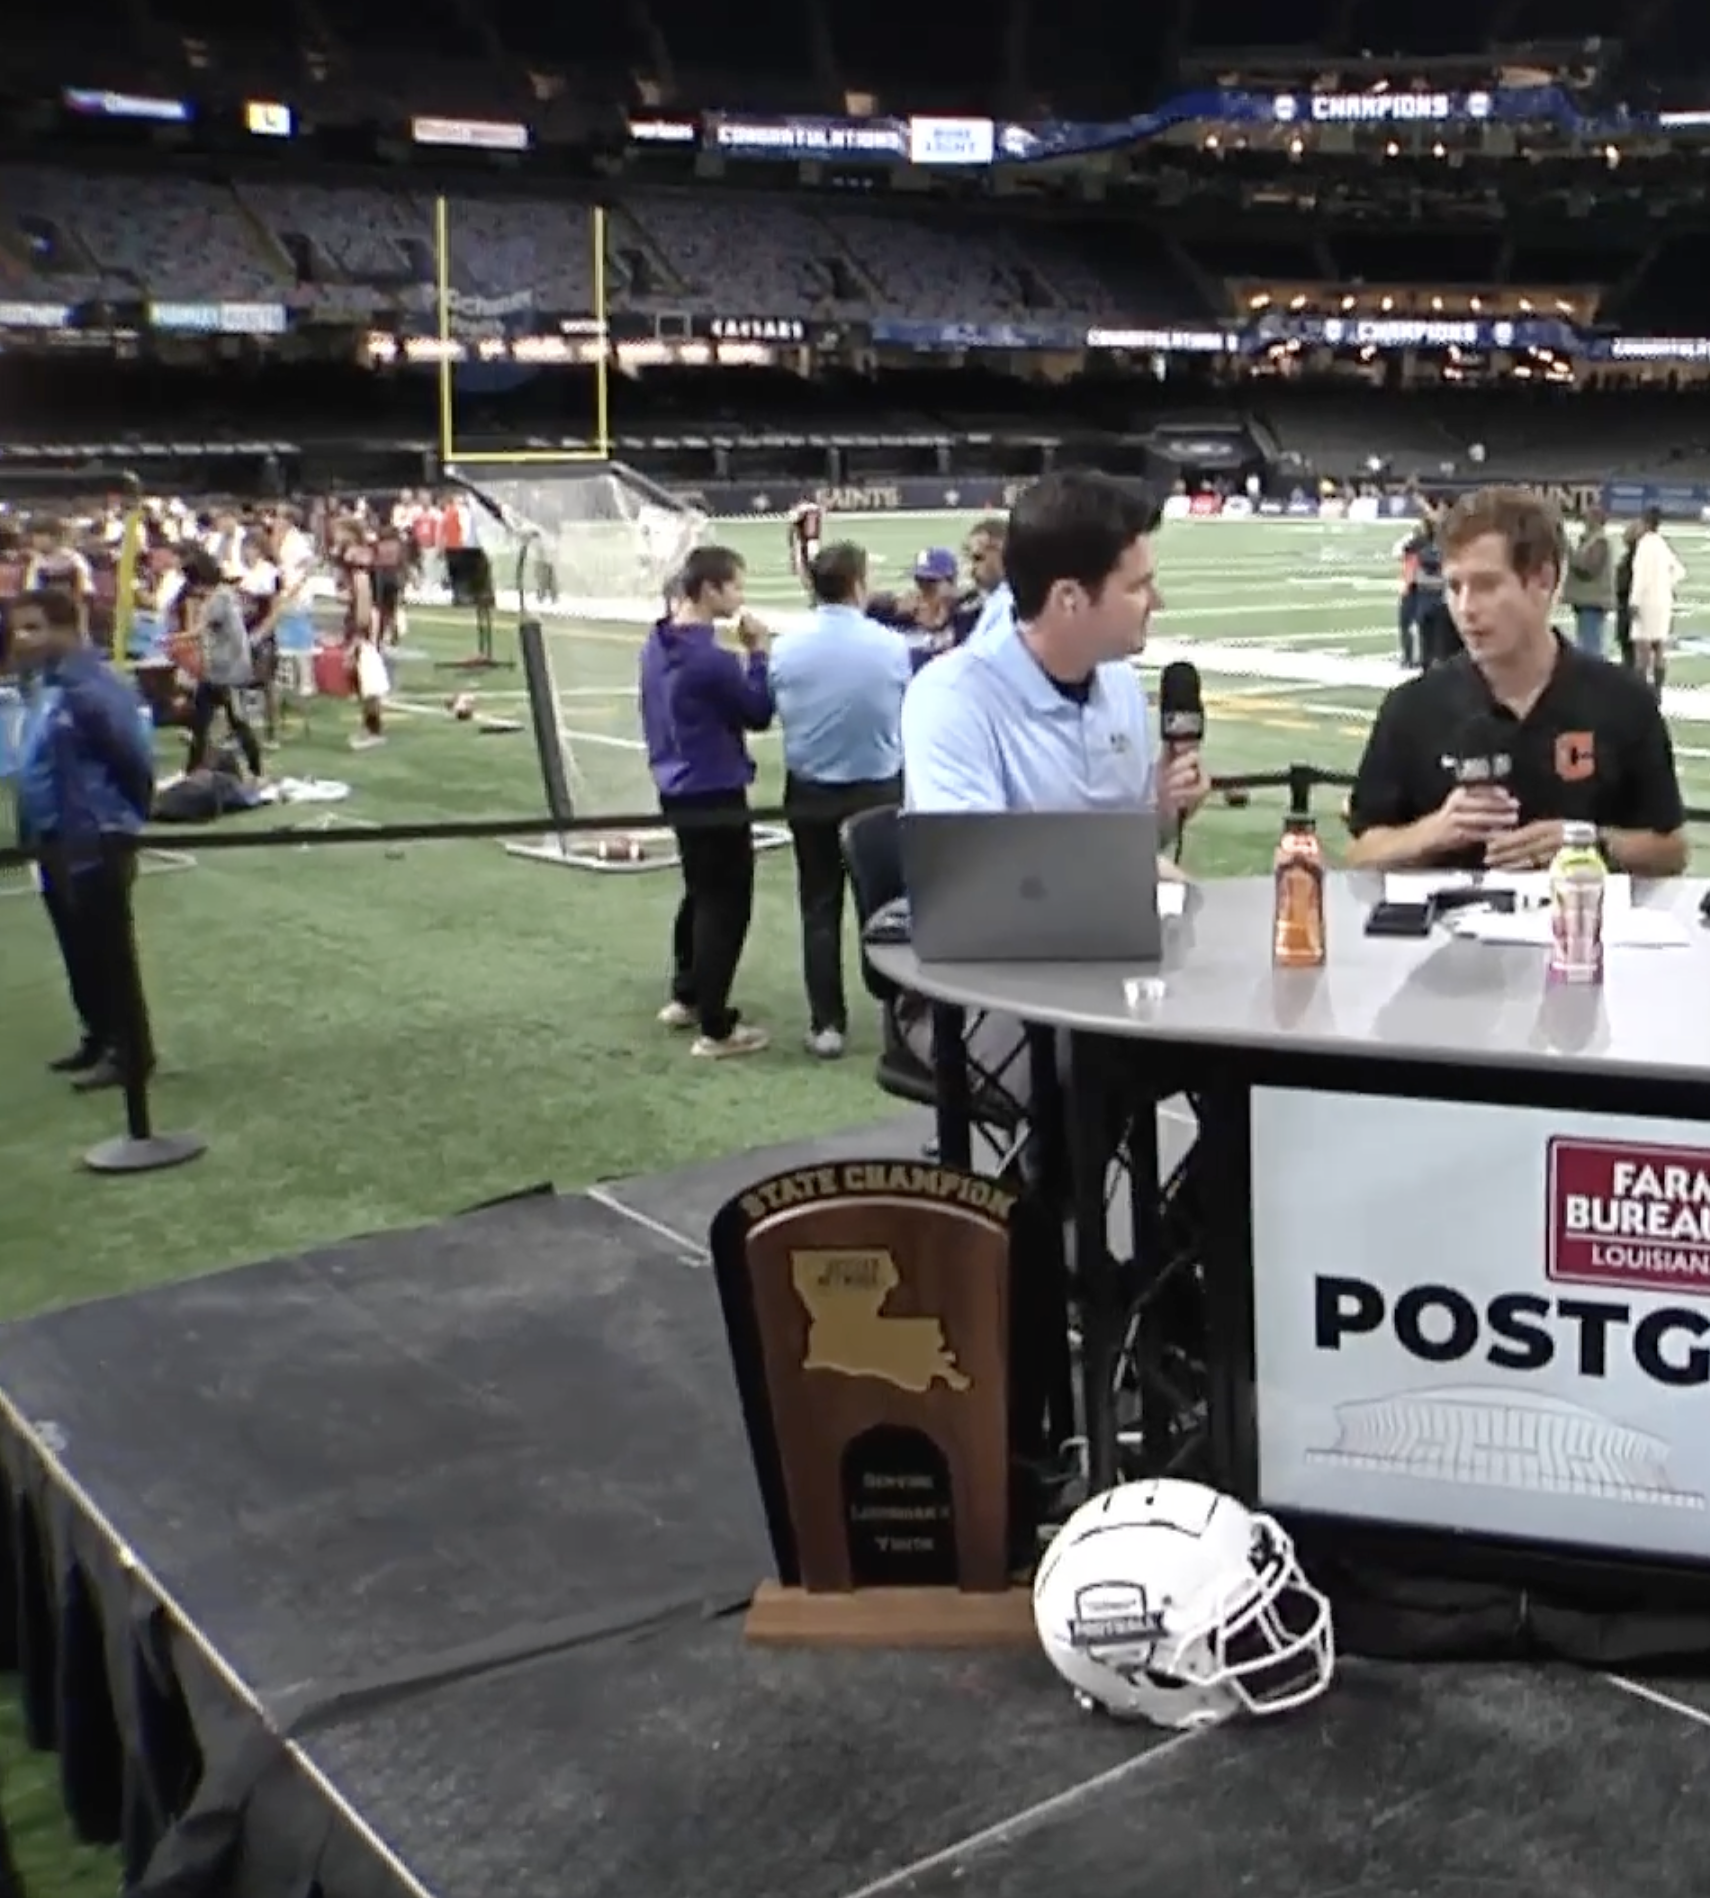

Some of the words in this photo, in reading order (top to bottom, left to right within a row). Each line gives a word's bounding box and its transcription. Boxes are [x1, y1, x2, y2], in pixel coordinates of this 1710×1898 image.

[1311, 94, 1449, 120] CHAMPIONS
[711, 318, 804, 340] CAESARS
[1356, 320, 1478, 344] CHAMPIONS
[1555, 731, 1596, 782] C
[740, 1167, 839, 1219] STATE
